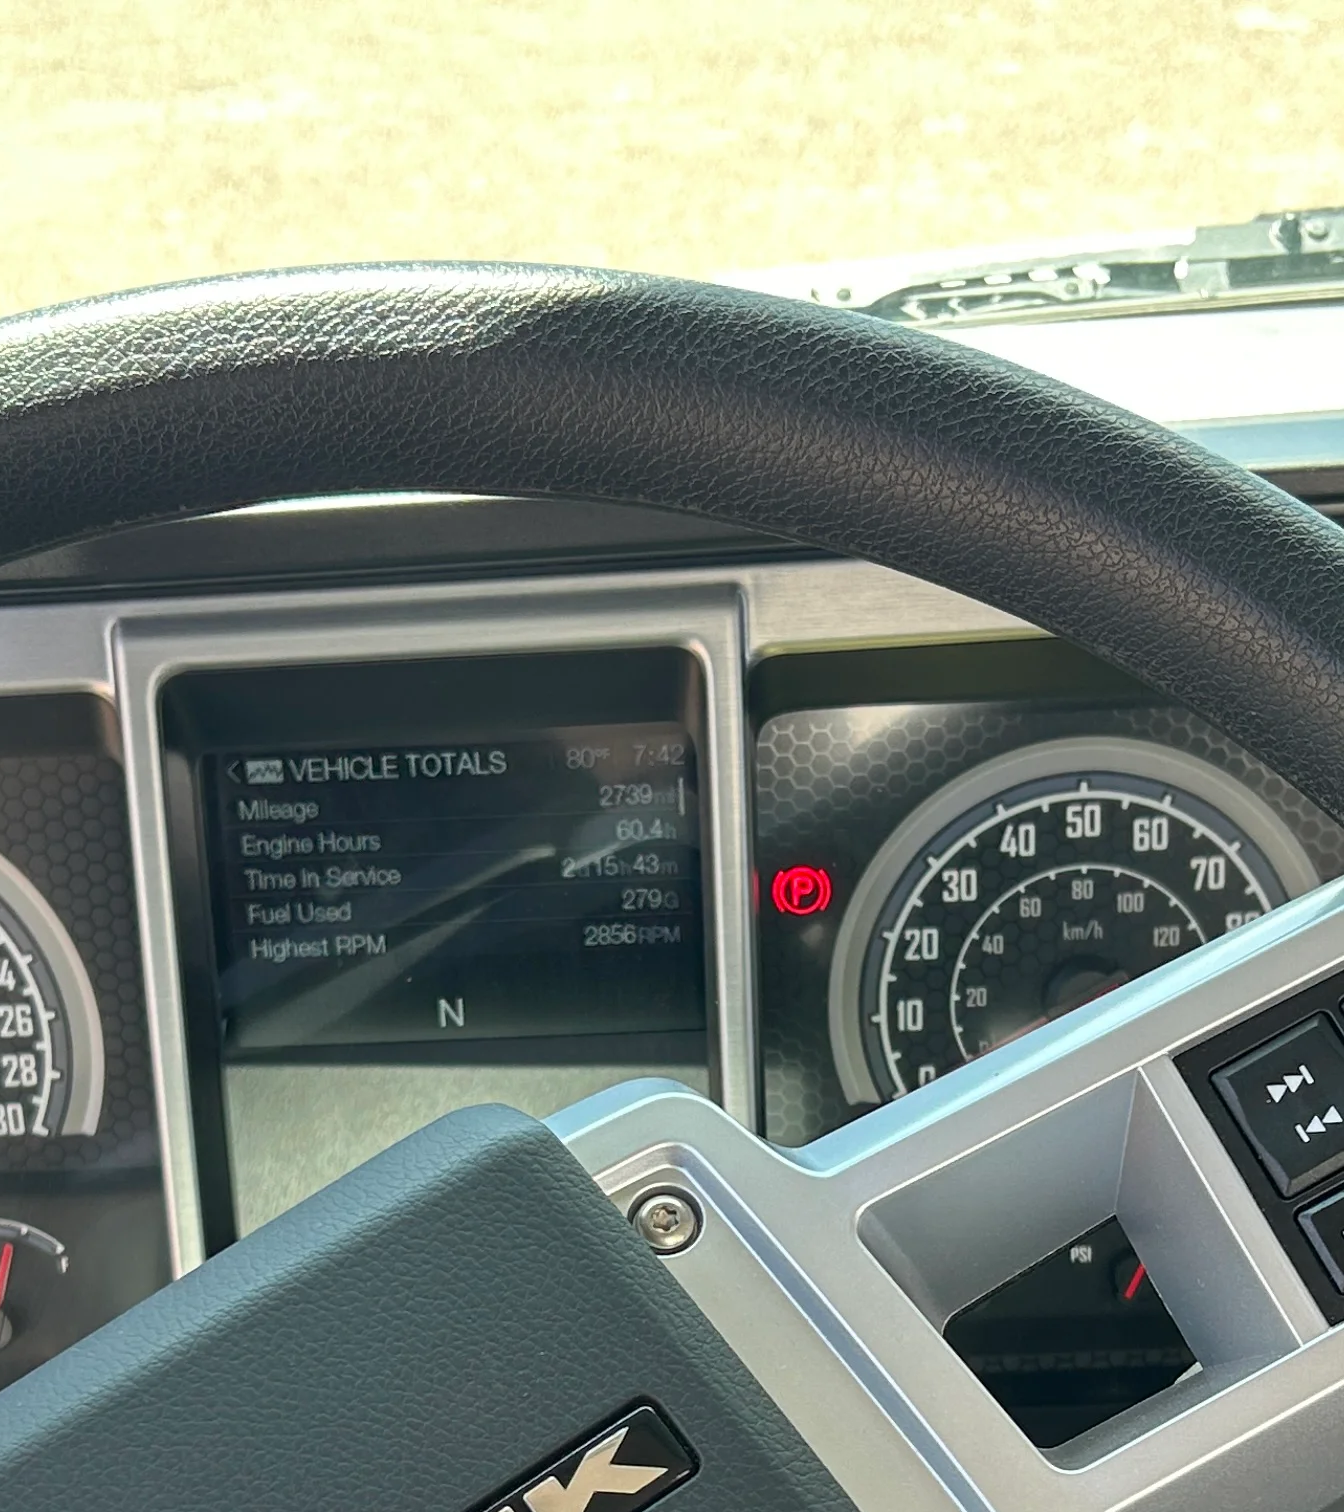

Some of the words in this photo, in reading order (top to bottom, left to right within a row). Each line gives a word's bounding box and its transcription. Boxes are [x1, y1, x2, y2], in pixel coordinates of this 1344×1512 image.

[289, 756, 399, 782] VEHICLE
[406, 751, 507, 778] TOTALS
[632, 744, 685, 766] 7:42
[238, 800, 319, 824] Mileage
[1065, 804, 1101, 838] 50
[241, 834, 313, 859] Engine
[319, 831, 381, 853] Hours
[1000, 823, 1036, 857] 40
[1133, 818, 1168, 852] 60
[244, 868, 296, 891] Time
[326, 865, 402, 888] Service
[942, 869, 977, 903] 30
[1190, 856, 1226, 891] 70
[1071, 880, 1093, 901] 80
[1116, 893, 1144, 914] 100
[248, 903, 290, 925] Fuel
[297, 902, 352, 923] Used
[1019, 898, 1042, 918] 60
[904, 929, 939, 961] 20
[982, 935, 1004, 955] 40
[1062, 921, 1103, 942] km/h
[1153, 927, 1179, 948] 120
[251, 938, 329, 963] Highest
[335, 934, 387, 955] RPM
[966, 988, 987, 1008] 20
[437, 997, 465, 1029] N
[896, 999, 924, 1032] 10
[3, 1054, 38, 1088] 28
[1069, 1245, 1092, 1263] PSI
